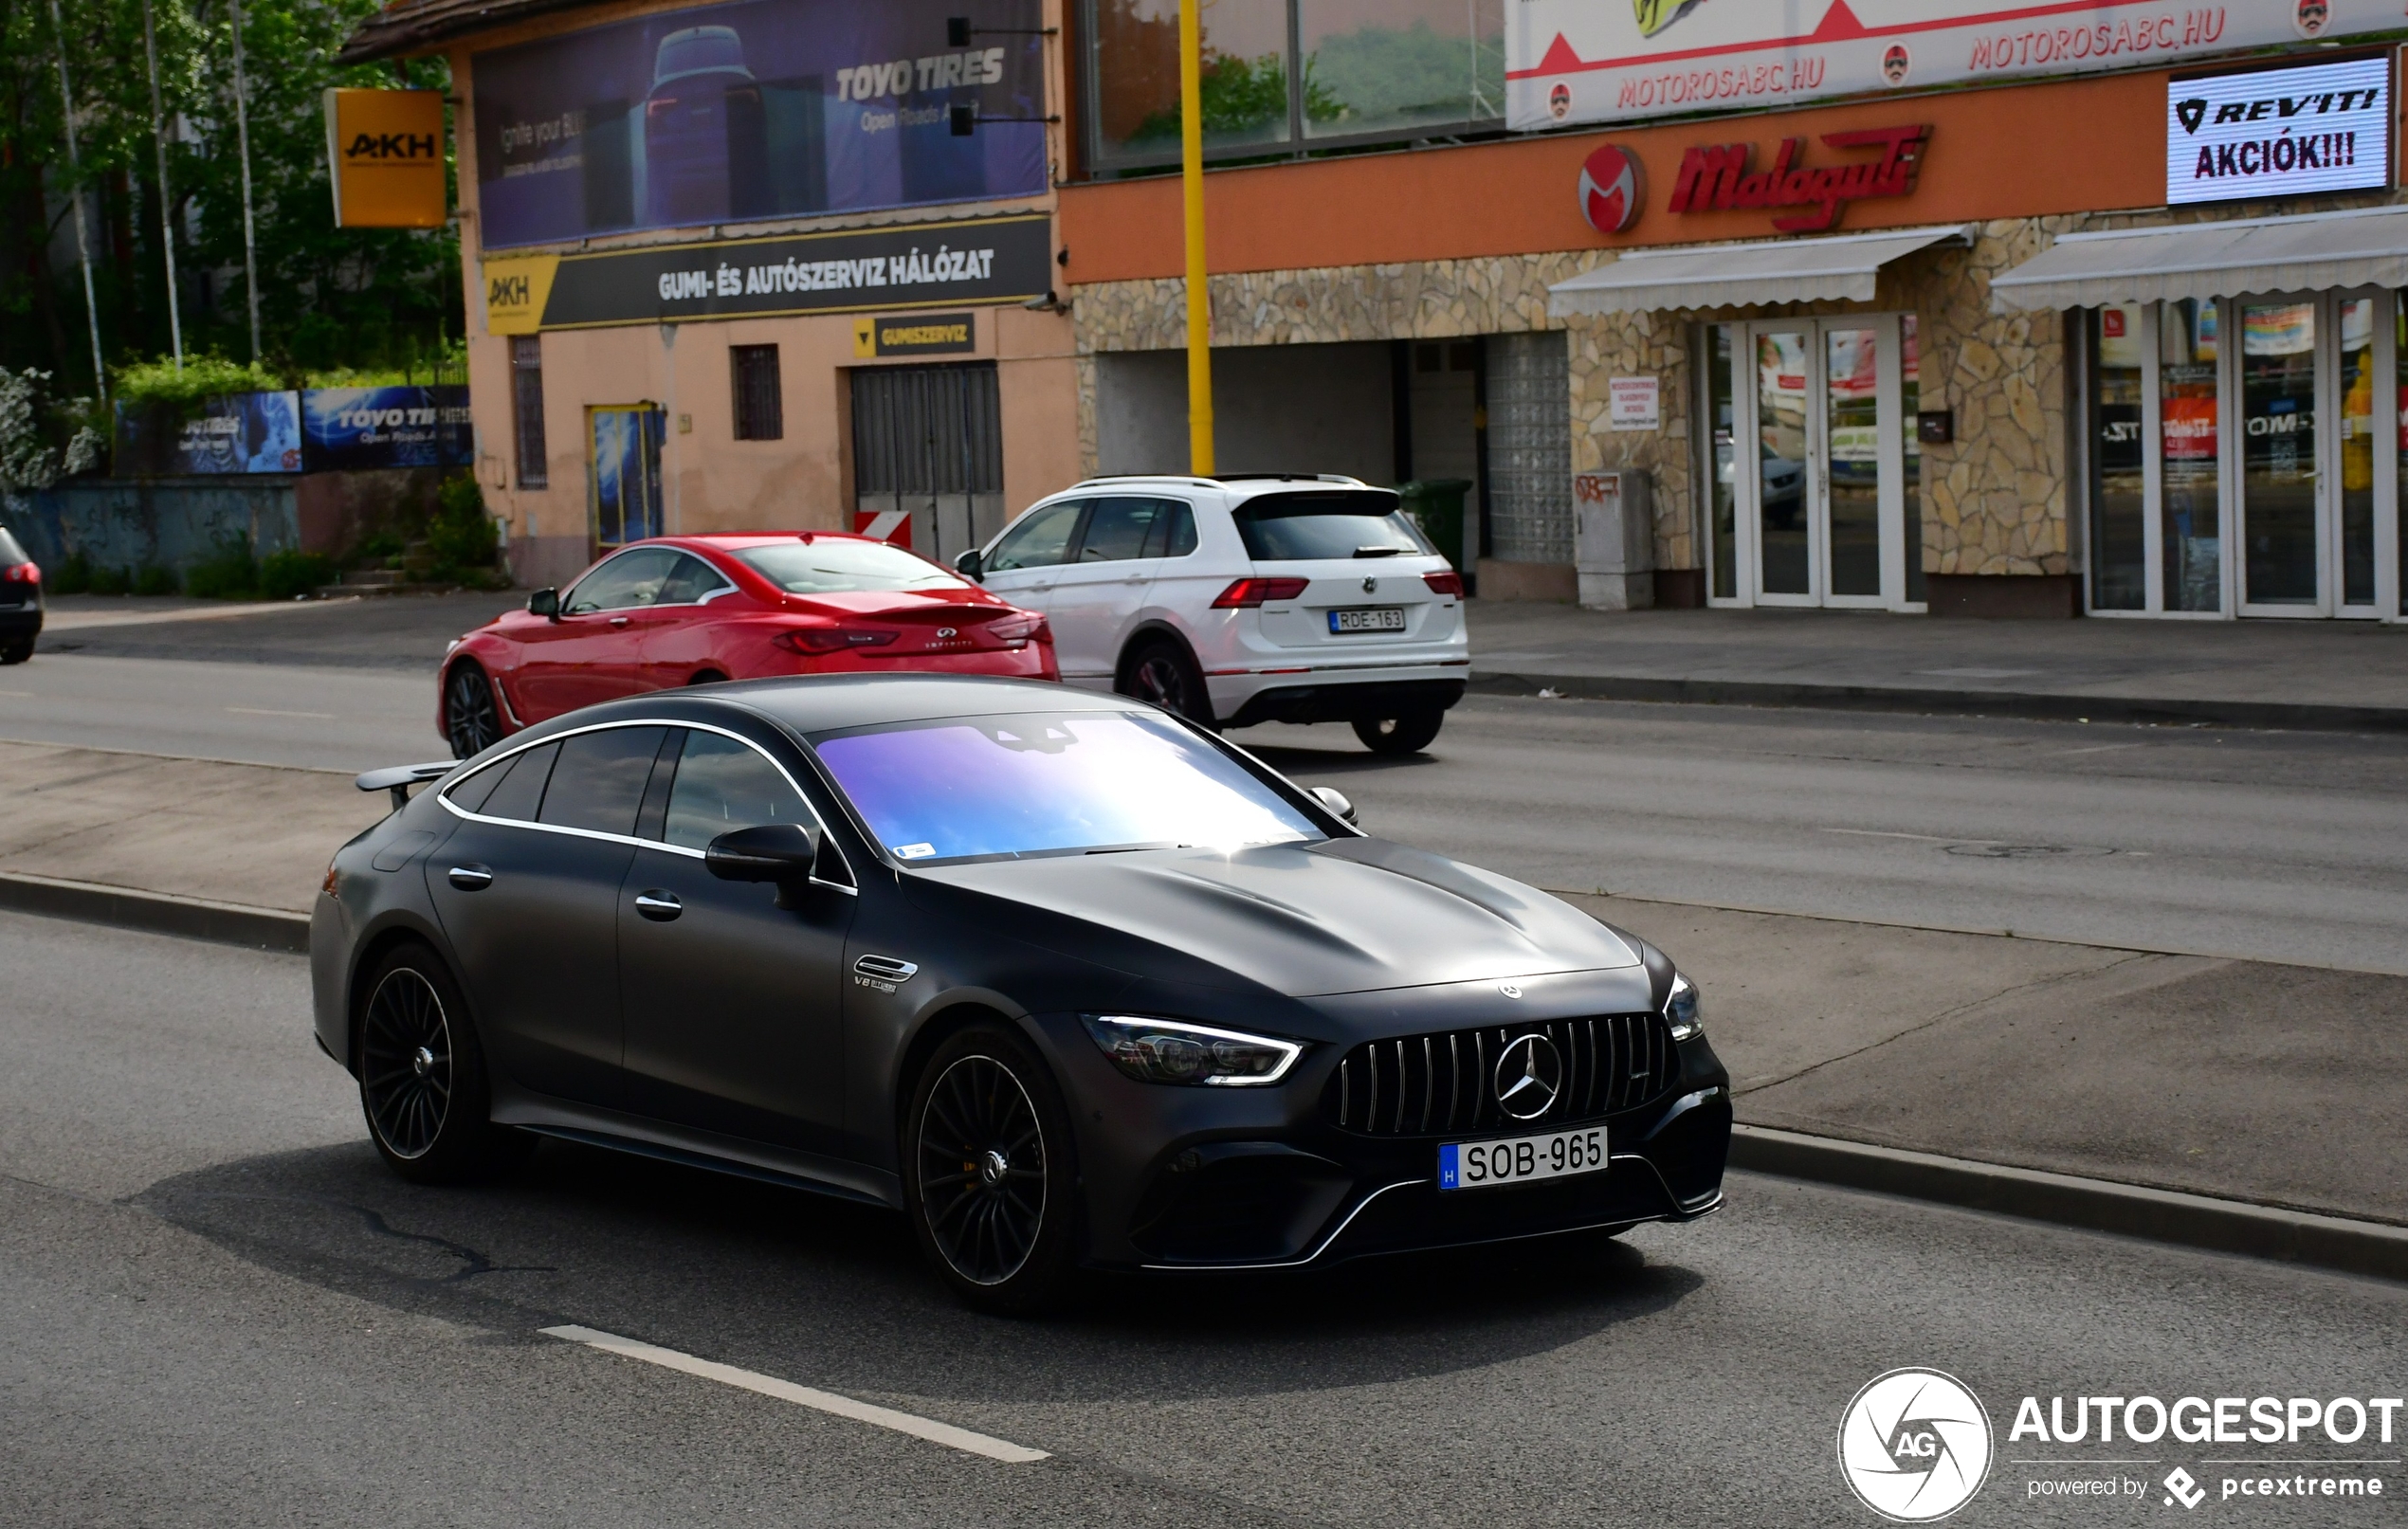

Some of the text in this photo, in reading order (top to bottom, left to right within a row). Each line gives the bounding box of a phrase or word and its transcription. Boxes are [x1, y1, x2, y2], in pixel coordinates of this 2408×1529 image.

[1968, 8, 2225, 70] MOTOROSABC.HU
[836, 47, 1005, 102] TOYO TIRES
[1617, 56, 1826, 109] MOTOROSABC.HU
[860, 112, 895, 134] Open
[345, 134, 435, 158] AKH
[2195, 128, 2357, 178] AKCIÓK!!!
[1669, 125, 1930, 231] Malaguti
[658, 245, 994, 300] GUMI- ÉS AUTÓSZERVIZ HÁLÓZAT
[489, 276, 529, 306] AKH
[882, 323, 967, 347] GUMISZERVIZ
[339, 408, 404, 428] TOYO
[1341, 611, 1401, 628] RDE-163
[854, 975, 870, 987] V8
[1467, 1132, 1601, 1181] SOB-965
[1445, 1170, 1454, 1183] H
